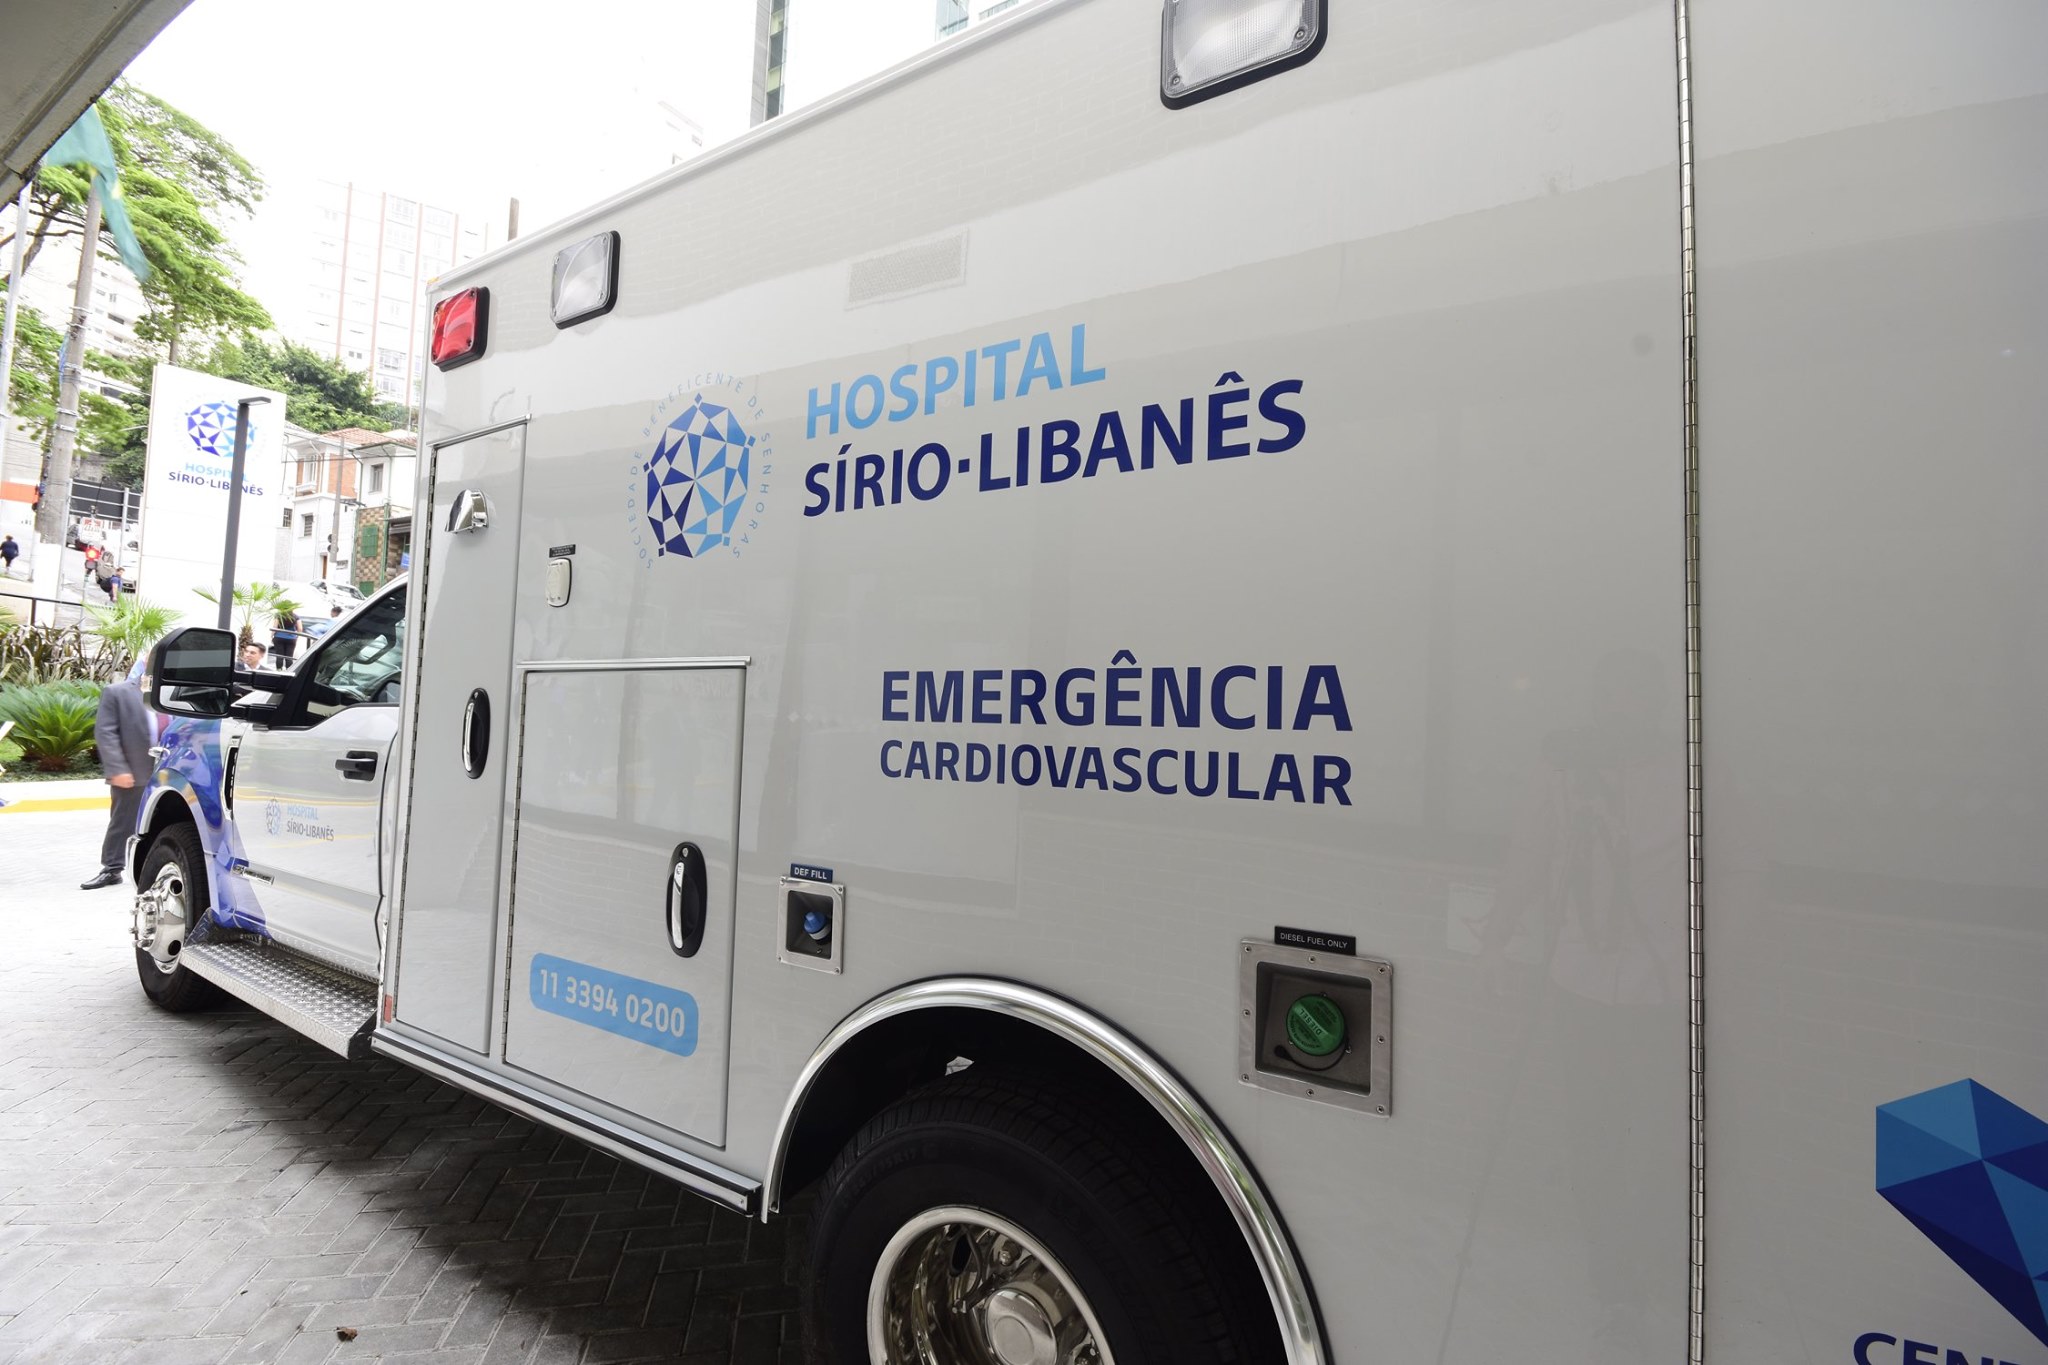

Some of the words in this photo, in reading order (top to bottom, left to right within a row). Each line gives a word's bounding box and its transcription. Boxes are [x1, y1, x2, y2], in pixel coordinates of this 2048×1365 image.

[643, 372, 743, 437] BENEFICENTE
[747, 396, 764, 421] DE
[806, 323, 1106, 440] HOSPITAL
[185, 462, 249, 482] HOSPITL
[733, 432, 772, 558] SENHORAS
[628, 451, 653, 569] SOCIEDADE
[882, 649, 1353, 732] EMERGÊNCIA
[880, 739, 1353, 806] CARDIOVASCULAR
[287, 804, 318, 820] HOSPITAL
[794, 867, 809, 877] DEF
[811, 869, 827, 880] FILL
[1280, 932, 1305, 943] DIESEL
[1307, 936, 1325, 946] FUEL
[1327, 939, 1348, 949] ONLY
[540, 969, 558, 999] 11
[565, 976, 619, 1017] 3394
[625, 993, 685, 1038] 0200
[1300, 1008, 1322, 1036] DIESEL
